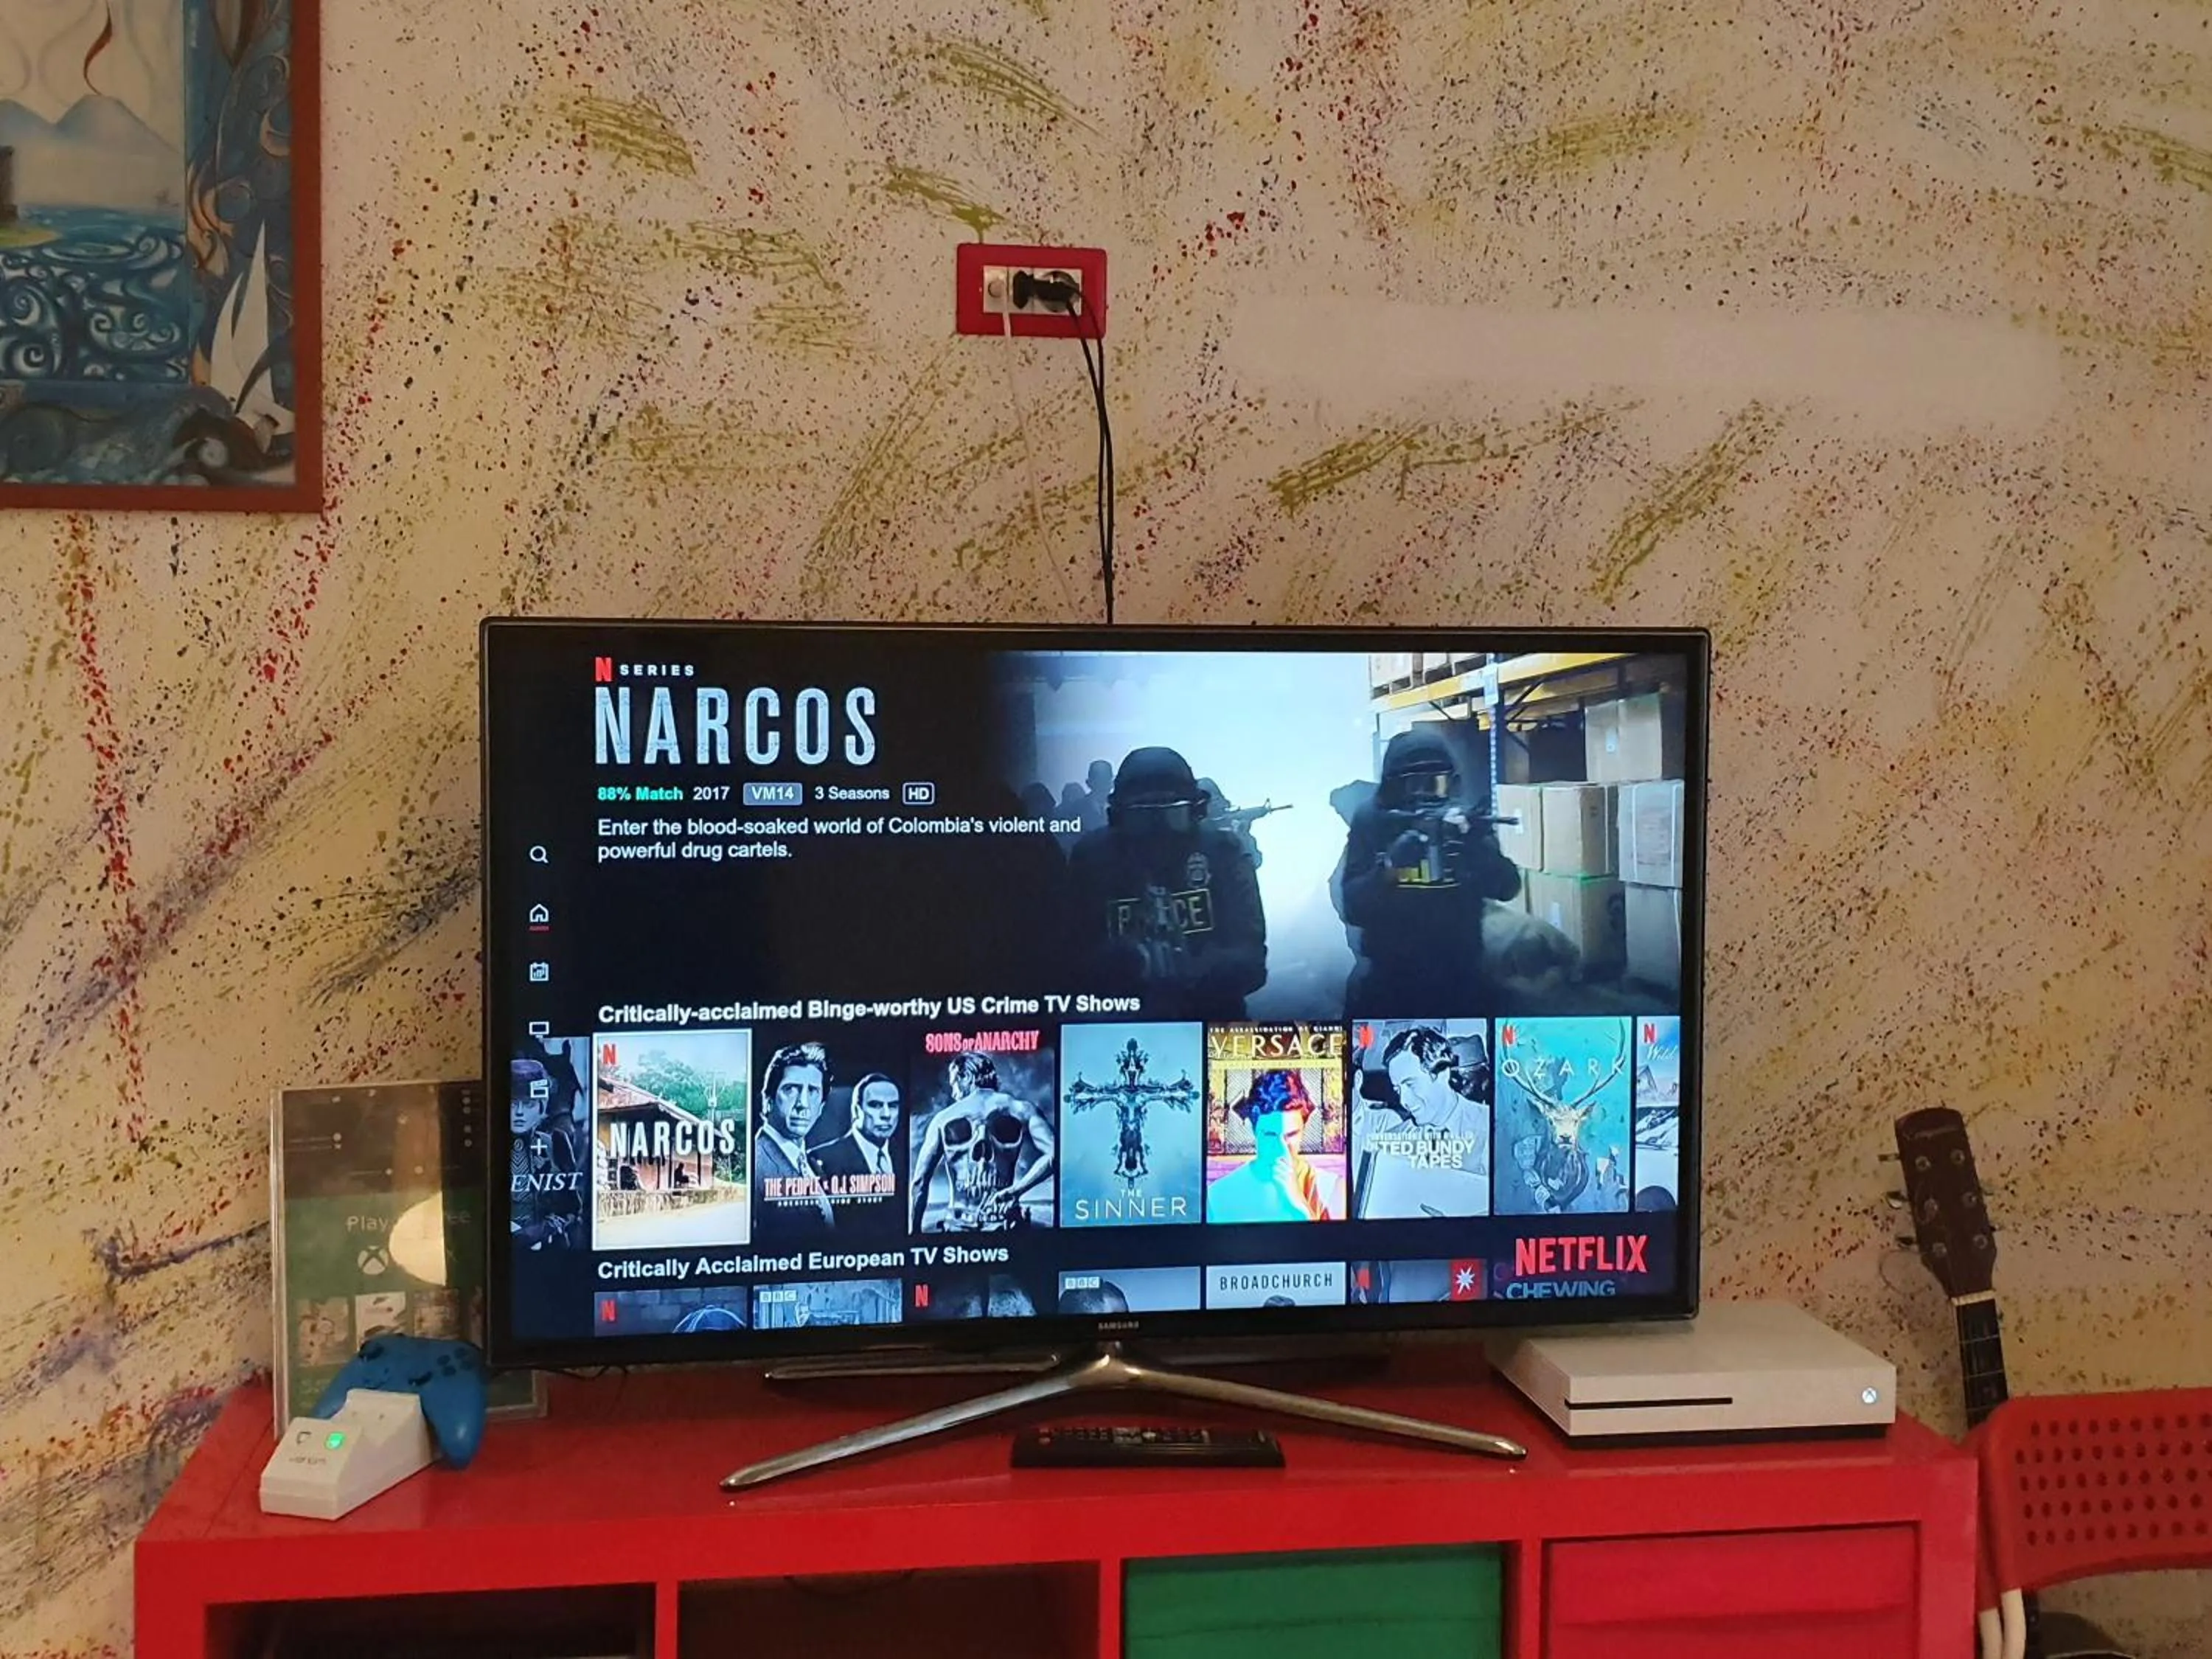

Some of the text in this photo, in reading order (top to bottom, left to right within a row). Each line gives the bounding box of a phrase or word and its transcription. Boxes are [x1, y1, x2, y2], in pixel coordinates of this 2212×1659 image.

[595, 657, 695, 682] N SERIES
[595, 686, 876, 766] NARCOS
[597, 785, 930, 801] 88% Match 2017 VM14 3 Seasons HD
[598, 816, 1081, 835] Enter the blood-soaked world of Colombia's violent and
[598, 841, 793, 863] powerful drug cartels.
[599, 994, 1141, 1025] Critically-acclaimed Binge-worthy US Crime TV Shows
[925, 1032, 961, 1052] SONS
[975, 1029, 1039, 1051] ANARCHY
[1644, 1023, 1655, 1043] N
[603, 1044, 616, 1065] N
[1211, 1034, 1343, 1057] VERSACE
[1502, 1056, 1625, 1078] OZARK
[610, 1118, 735, 1158] NARCOS
[1380, 1141, 1413, 1155] TED
[1416, 1139, 1475, 1155] BUNDY
[1408, 1155, 1463, 1169] TAPES
[764, 1178, 782, 1196] THE
[785, 1176, 821, 1195] PEOPLE
[849, 1173, 896, 1193] SIMPSON
[1121, 1189, 1142, 1197] THE
[1075, 1196, 1187, 1220] SINNER
[346, 1215, 389, 1232] Play
[598, 1245, 1009, 1279] Critically Acclaimed European TV Shows
[1515, 1234, 1648, 1276] NETFLIX
[1220, 1273, 1333, 1290] BROADCHURCH
[1506, 1279, 1616, 1299] CHEWING
[915, 1284, 928, 1307] N
